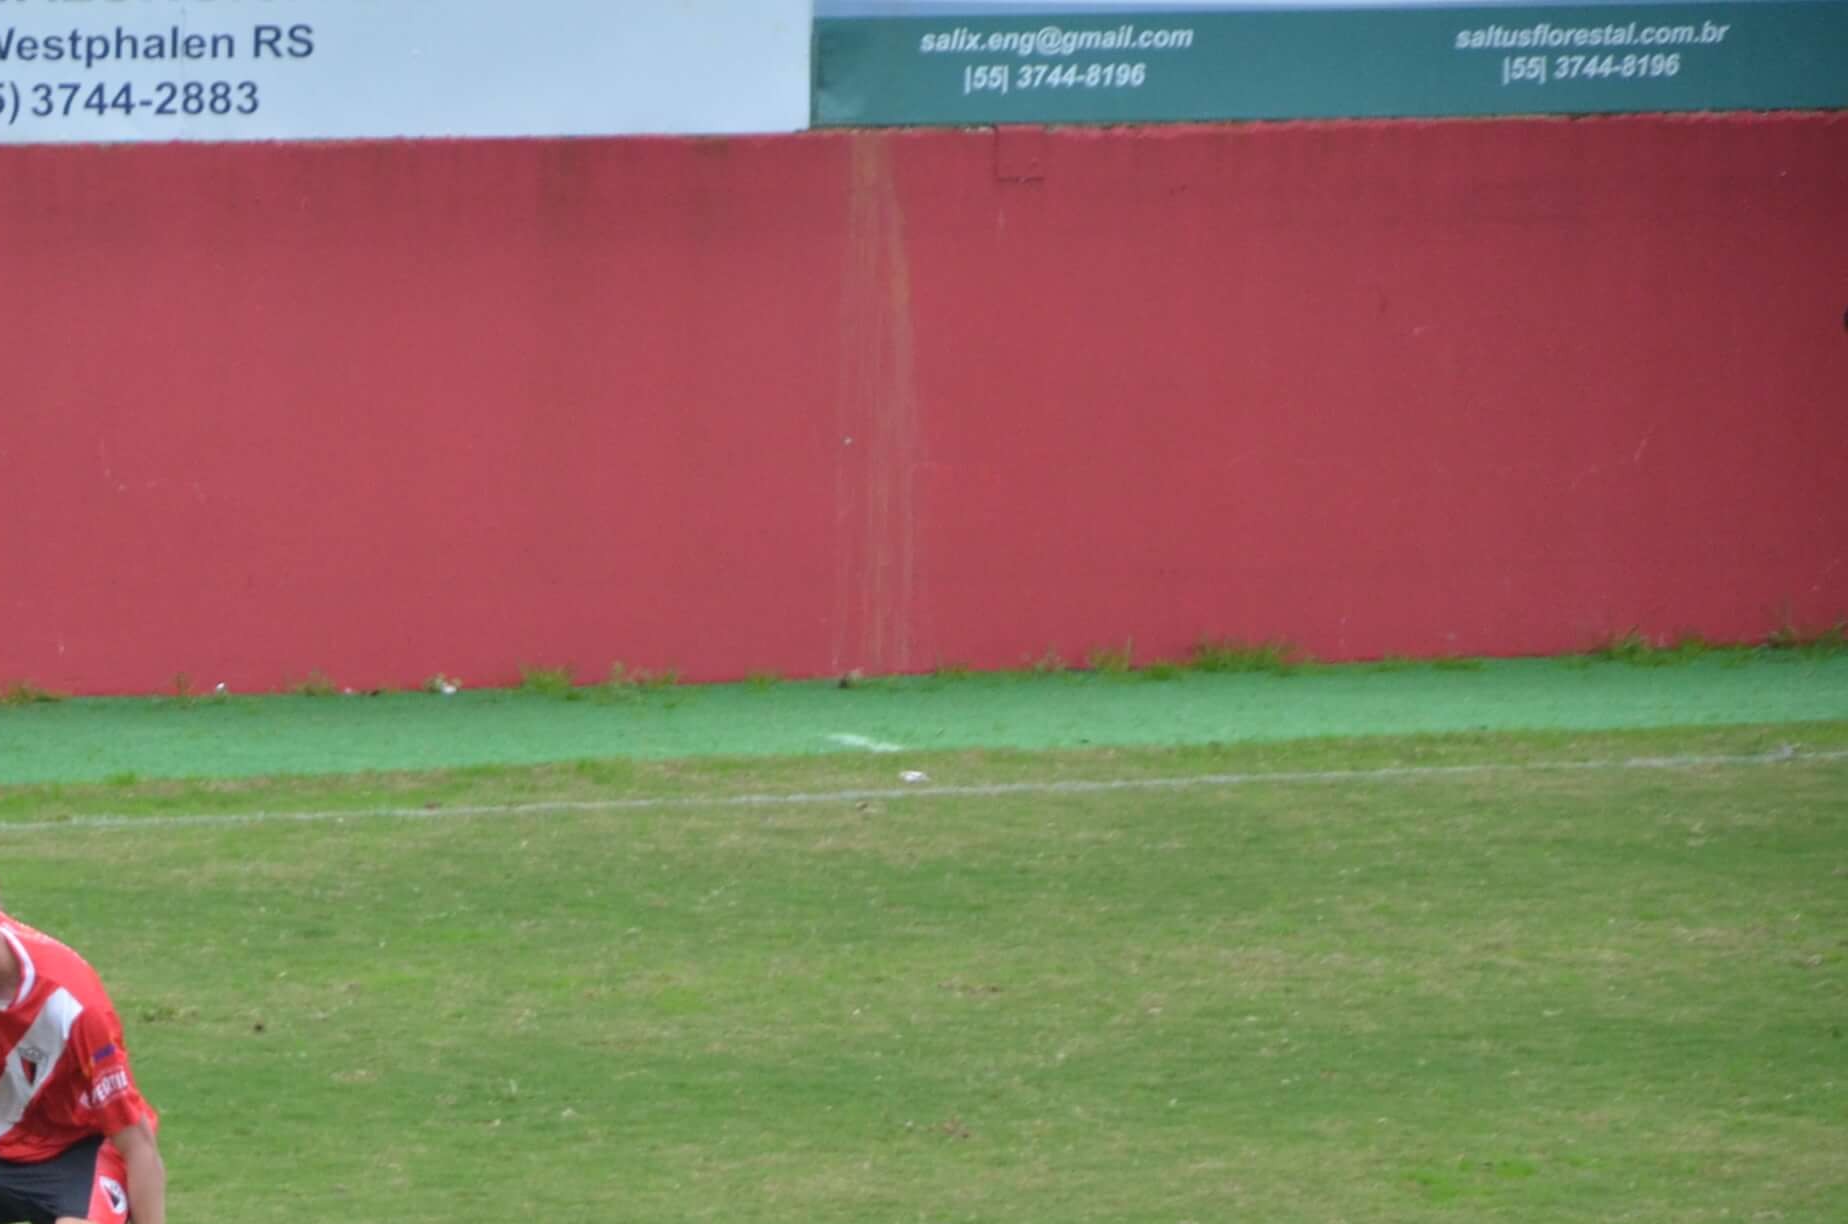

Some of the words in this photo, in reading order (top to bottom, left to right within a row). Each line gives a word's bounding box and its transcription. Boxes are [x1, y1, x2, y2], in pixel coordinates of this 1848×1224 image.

[252, 24, 315, 60] RS
[919, 25, 1195, 56] salix.eng@gmail.com
[1455, 19, 1730, 50] saltusflorestal.com.br
[1015, 62, 1147, 89] 3744-8196
[1553, 52, 1681, 80] 3744-8196
[30, 80, 260, 117] 3744-2883
